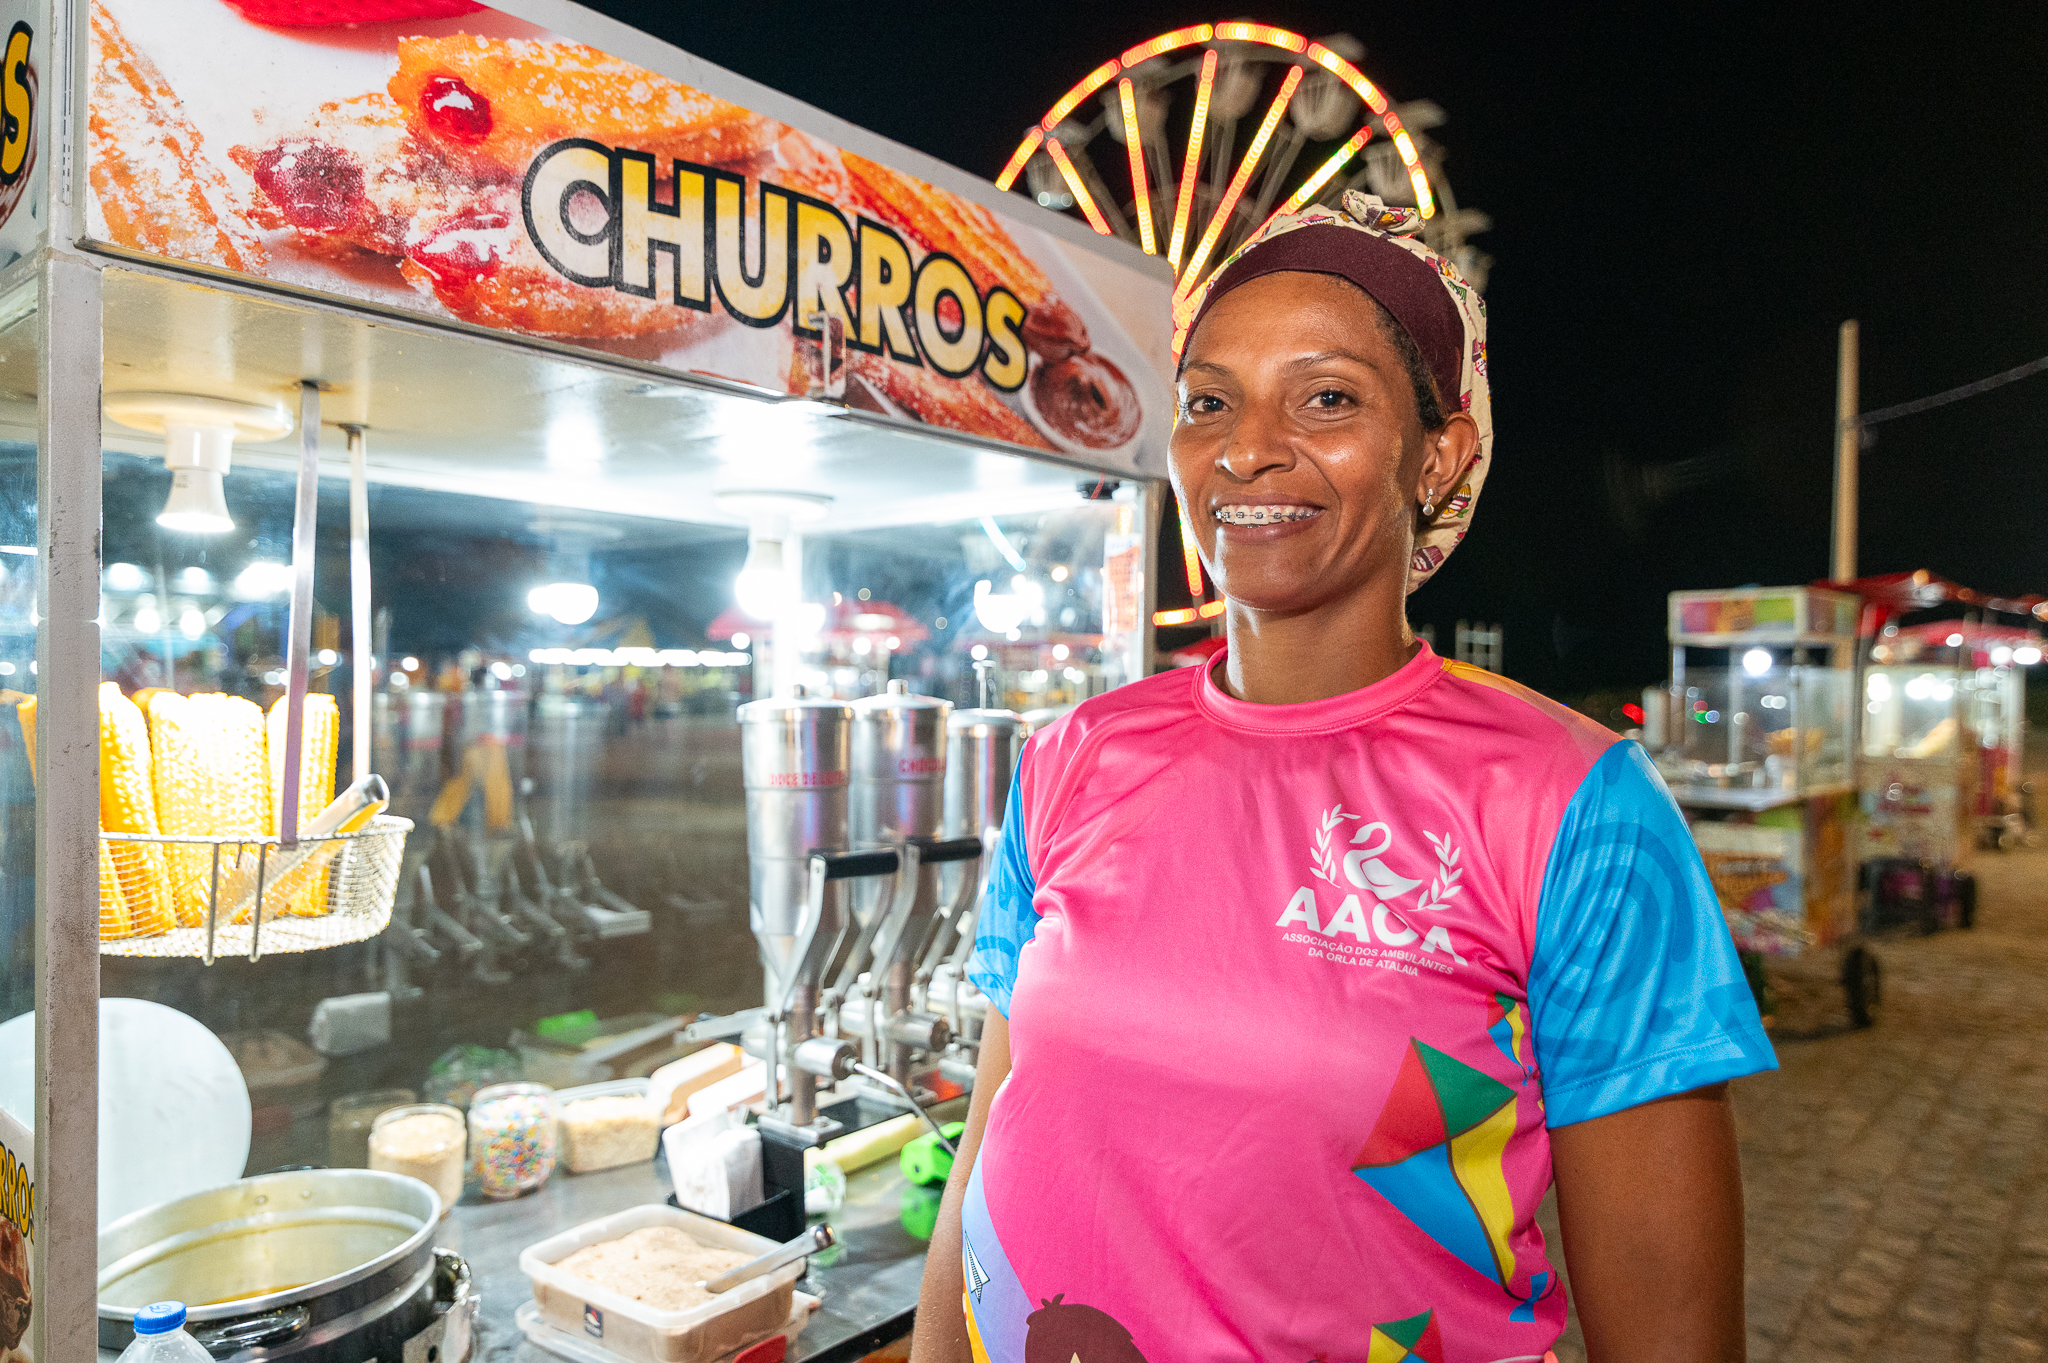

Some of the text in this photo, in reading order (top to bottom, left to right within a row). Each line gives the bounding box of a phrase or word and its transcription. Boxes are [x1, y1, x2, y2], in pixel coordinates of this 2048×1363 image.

[0, 20, 34, 186] S
[521, 138, 1029, 393] CHURROS
[1275, 885, 1468, 967] AACA
[1281, 932, 1454, 975] ASSOCIAÇÃO DOS AMBULANTES
[1308, 946, 1418, 977] DA ORLA DE ATALAIA
